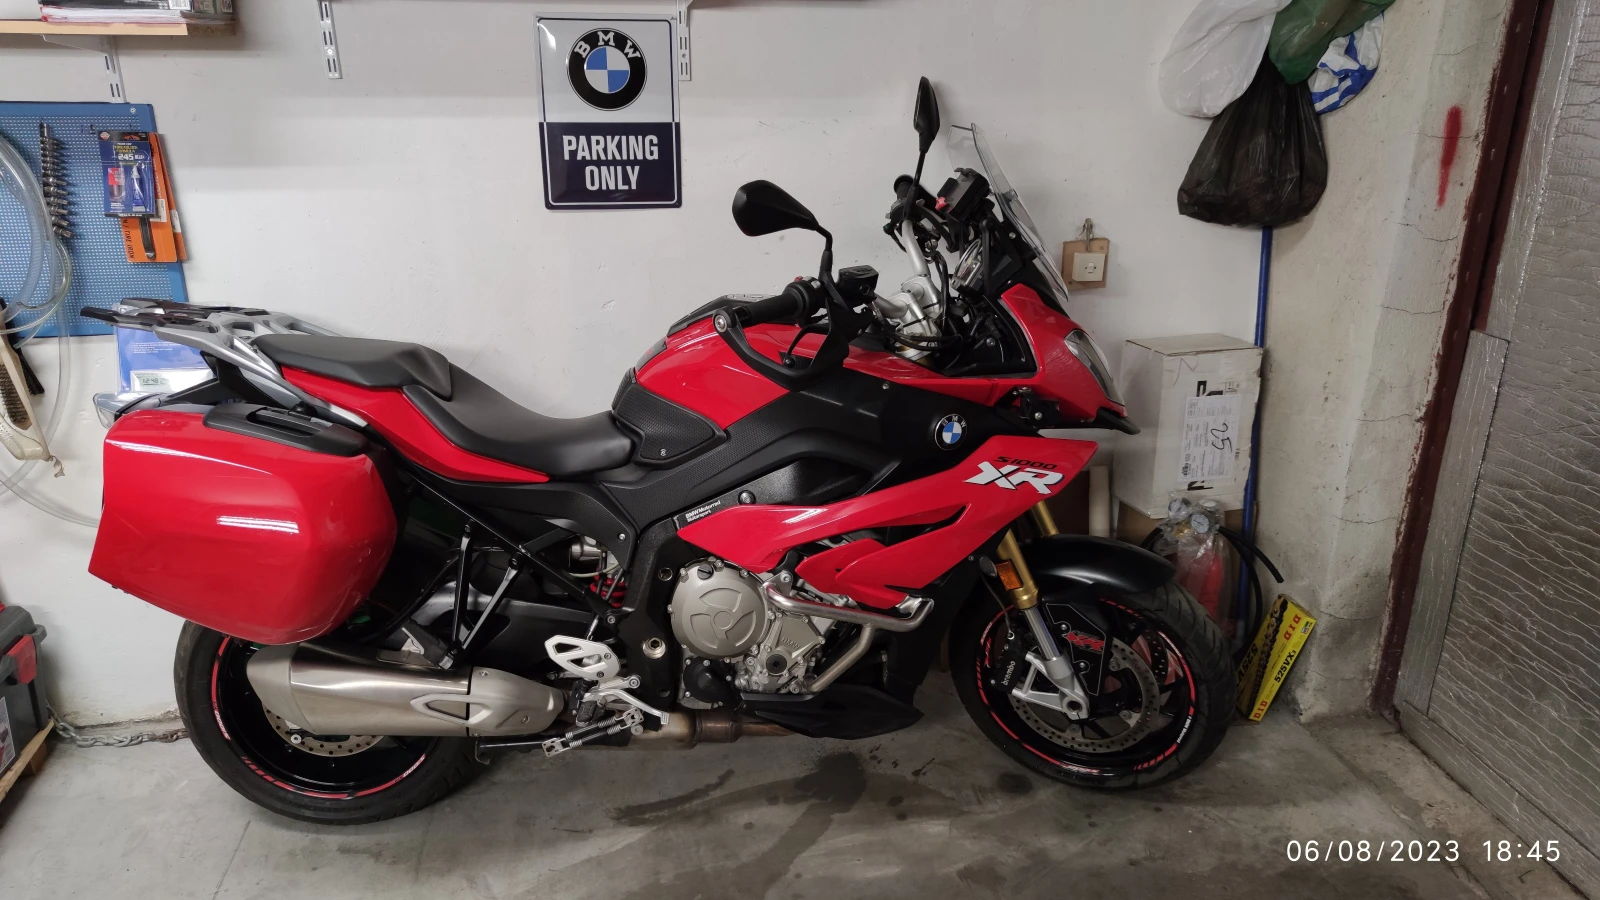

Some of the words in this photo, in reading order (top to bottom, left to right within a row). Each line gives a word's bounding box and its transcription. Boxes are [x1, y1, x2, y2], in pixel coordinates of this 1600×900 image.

[574, 31, 642, 59] BMW
[562, 135, 659, 161] PARKING
[584, 166, 640, 191] ONLY
[942, 415, 967, 428] BMW
[1210, 422, 1233, 453] 25
[993, 456, 1058, 470] S1000
[962, 461, 1065, 495] XR
[1001, 660, 1016, 686] brembo
